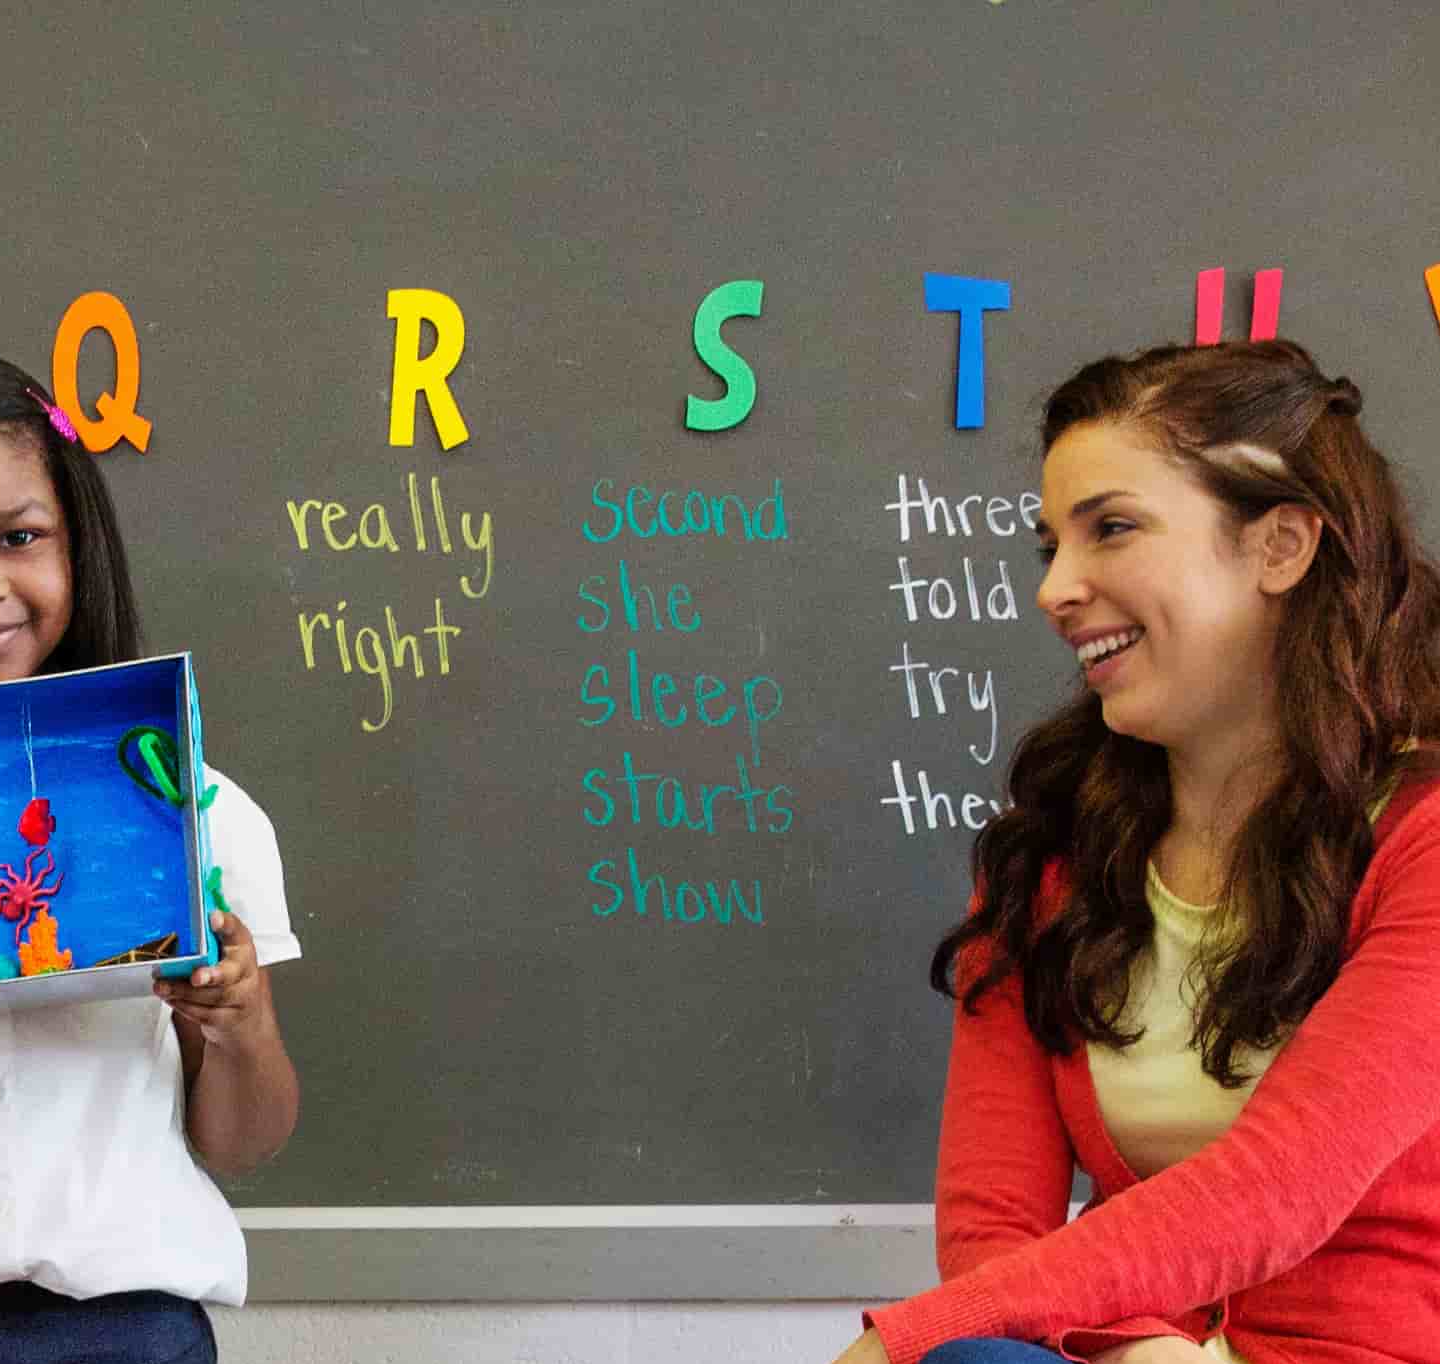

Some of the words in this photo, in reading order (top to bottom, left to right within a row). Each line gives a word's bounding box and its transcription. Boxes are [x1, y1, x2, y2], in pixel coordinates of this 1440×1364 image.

[52, 291, 152, 454] Q
[387, 288, 470, 450] R
[686, 279, 764, 431] S
[925, 272, 1011, 430] T
[286, 472, 494, 599] really
[582, 477, 788, 544] second
[578, 559, 702, 634] she
[889, 557, 1019, 622] told
[298, 598, 461, 732] right
[578, 649, 783, 766] sleep
[889, 642, 998, 764] try
[582, 752, 793, 833] starts
[590, 847, 765, 924] show
